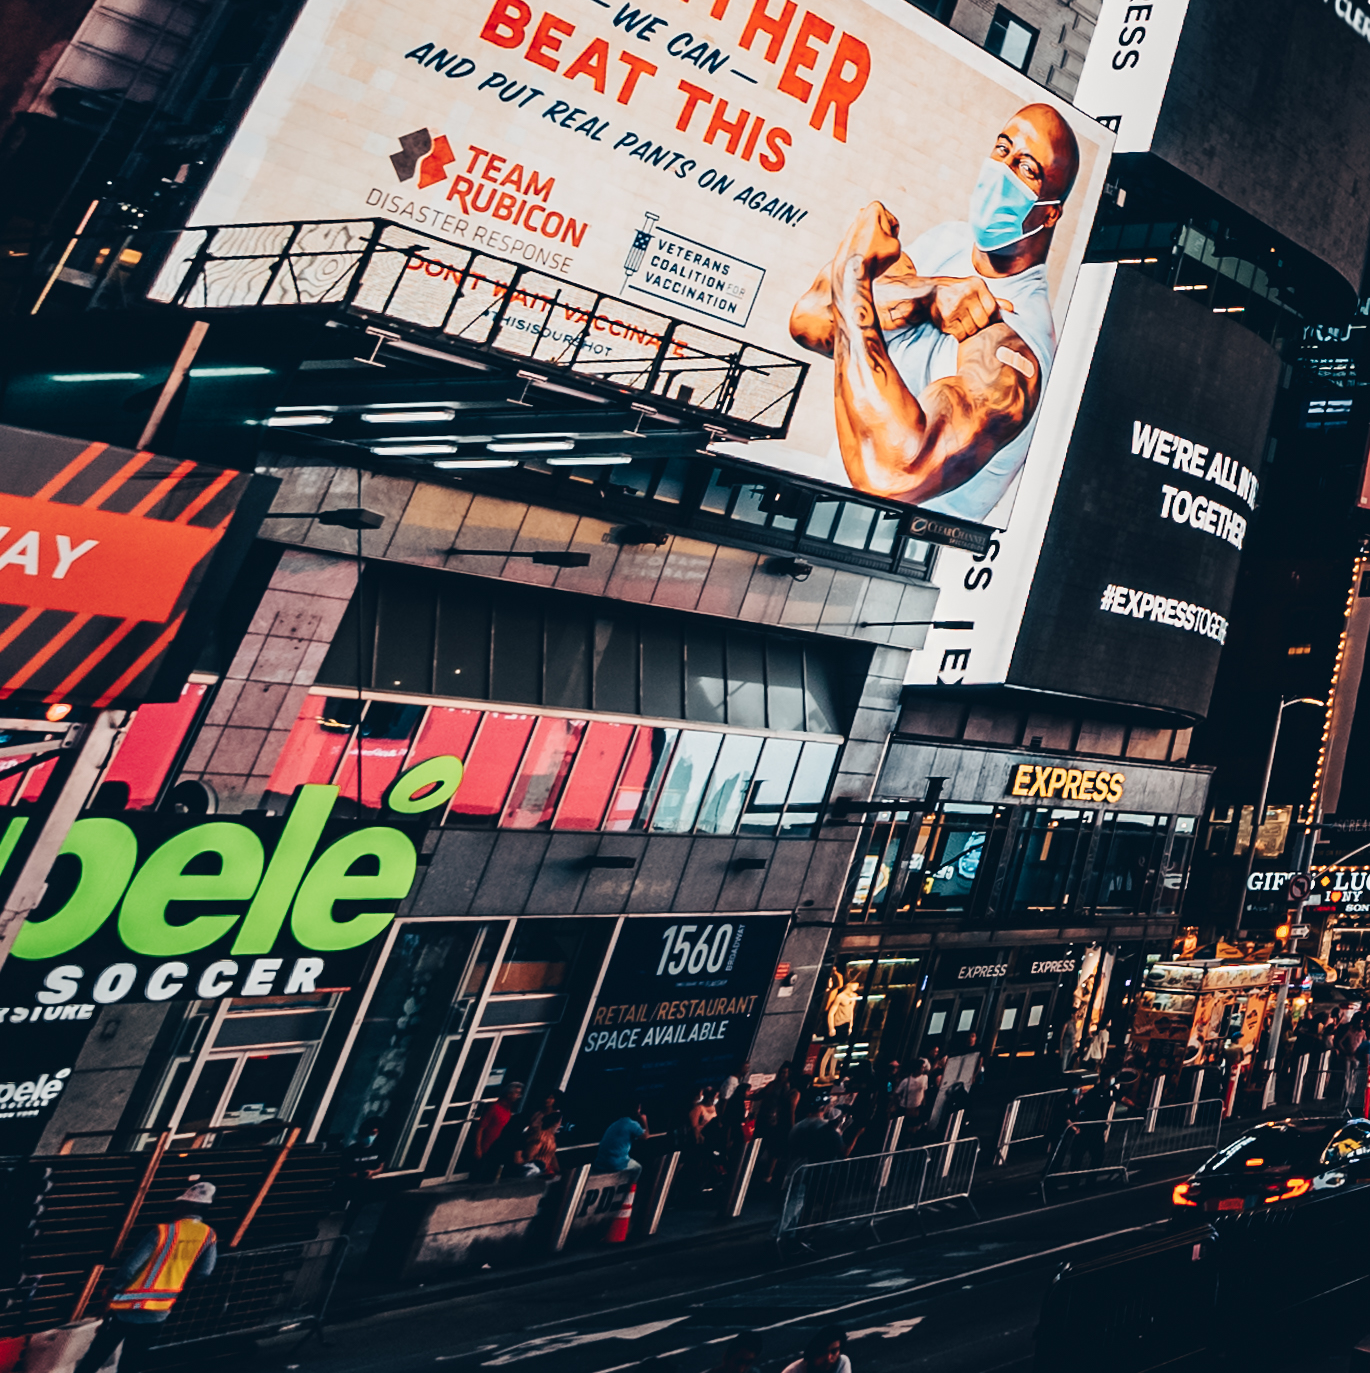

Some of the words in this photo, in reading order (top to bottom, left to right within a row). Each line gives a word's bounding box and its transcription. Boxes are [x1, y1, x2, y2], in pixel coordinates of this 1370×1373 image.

[611, 1, 669, 43] WE
[666, 31, 731, 76] CAN
[404, 41, 477, 81] AND
[477, 70, 546, 113] PUT
[541, 99, 612, 143] REAL
[612, 132, 698, 181] PANTS
[696, 167, 737, 198] ON
[731, 185, 810, 228] AGAIN!
[675, 79, 794, 173] THIS
[464, 144, 556, 204] TEAM
[365, 186, 470, 239] DISASTER
[474, 225, 574, 275] RESPONSE
[445, 174, 590, 249] RUBICON
[650, 256, 727, 292] COALITION
[656, 239, 731, 276] VETERANS
[644, 271, 738, 315] VACCINATION
[1131, 420, 1205, 479] WE'RE
[1205, 451, 1238, 494] ALL
[1160, 484, 1249, 550] TOGETHER
[0, 524, 100, 581] AY
[1011, 763, 1127, 805] EXPRESS
[1341, 891, 1365, 903] NY
[656, 923, 734, 976] 1560
[725, 923, 747, 972] BROADWAY
[957, 961, 1008, 980] EXPRESS
[1030, 958, 1075, 975] EXPRESS
[36, 955, 327, 1007] SOCCER
[584, 1028, 641, 1053] SPACE
[641, 1019, 729, 1048] AVAILABLE
[593, 1003, 649, 1027] RETAIL
